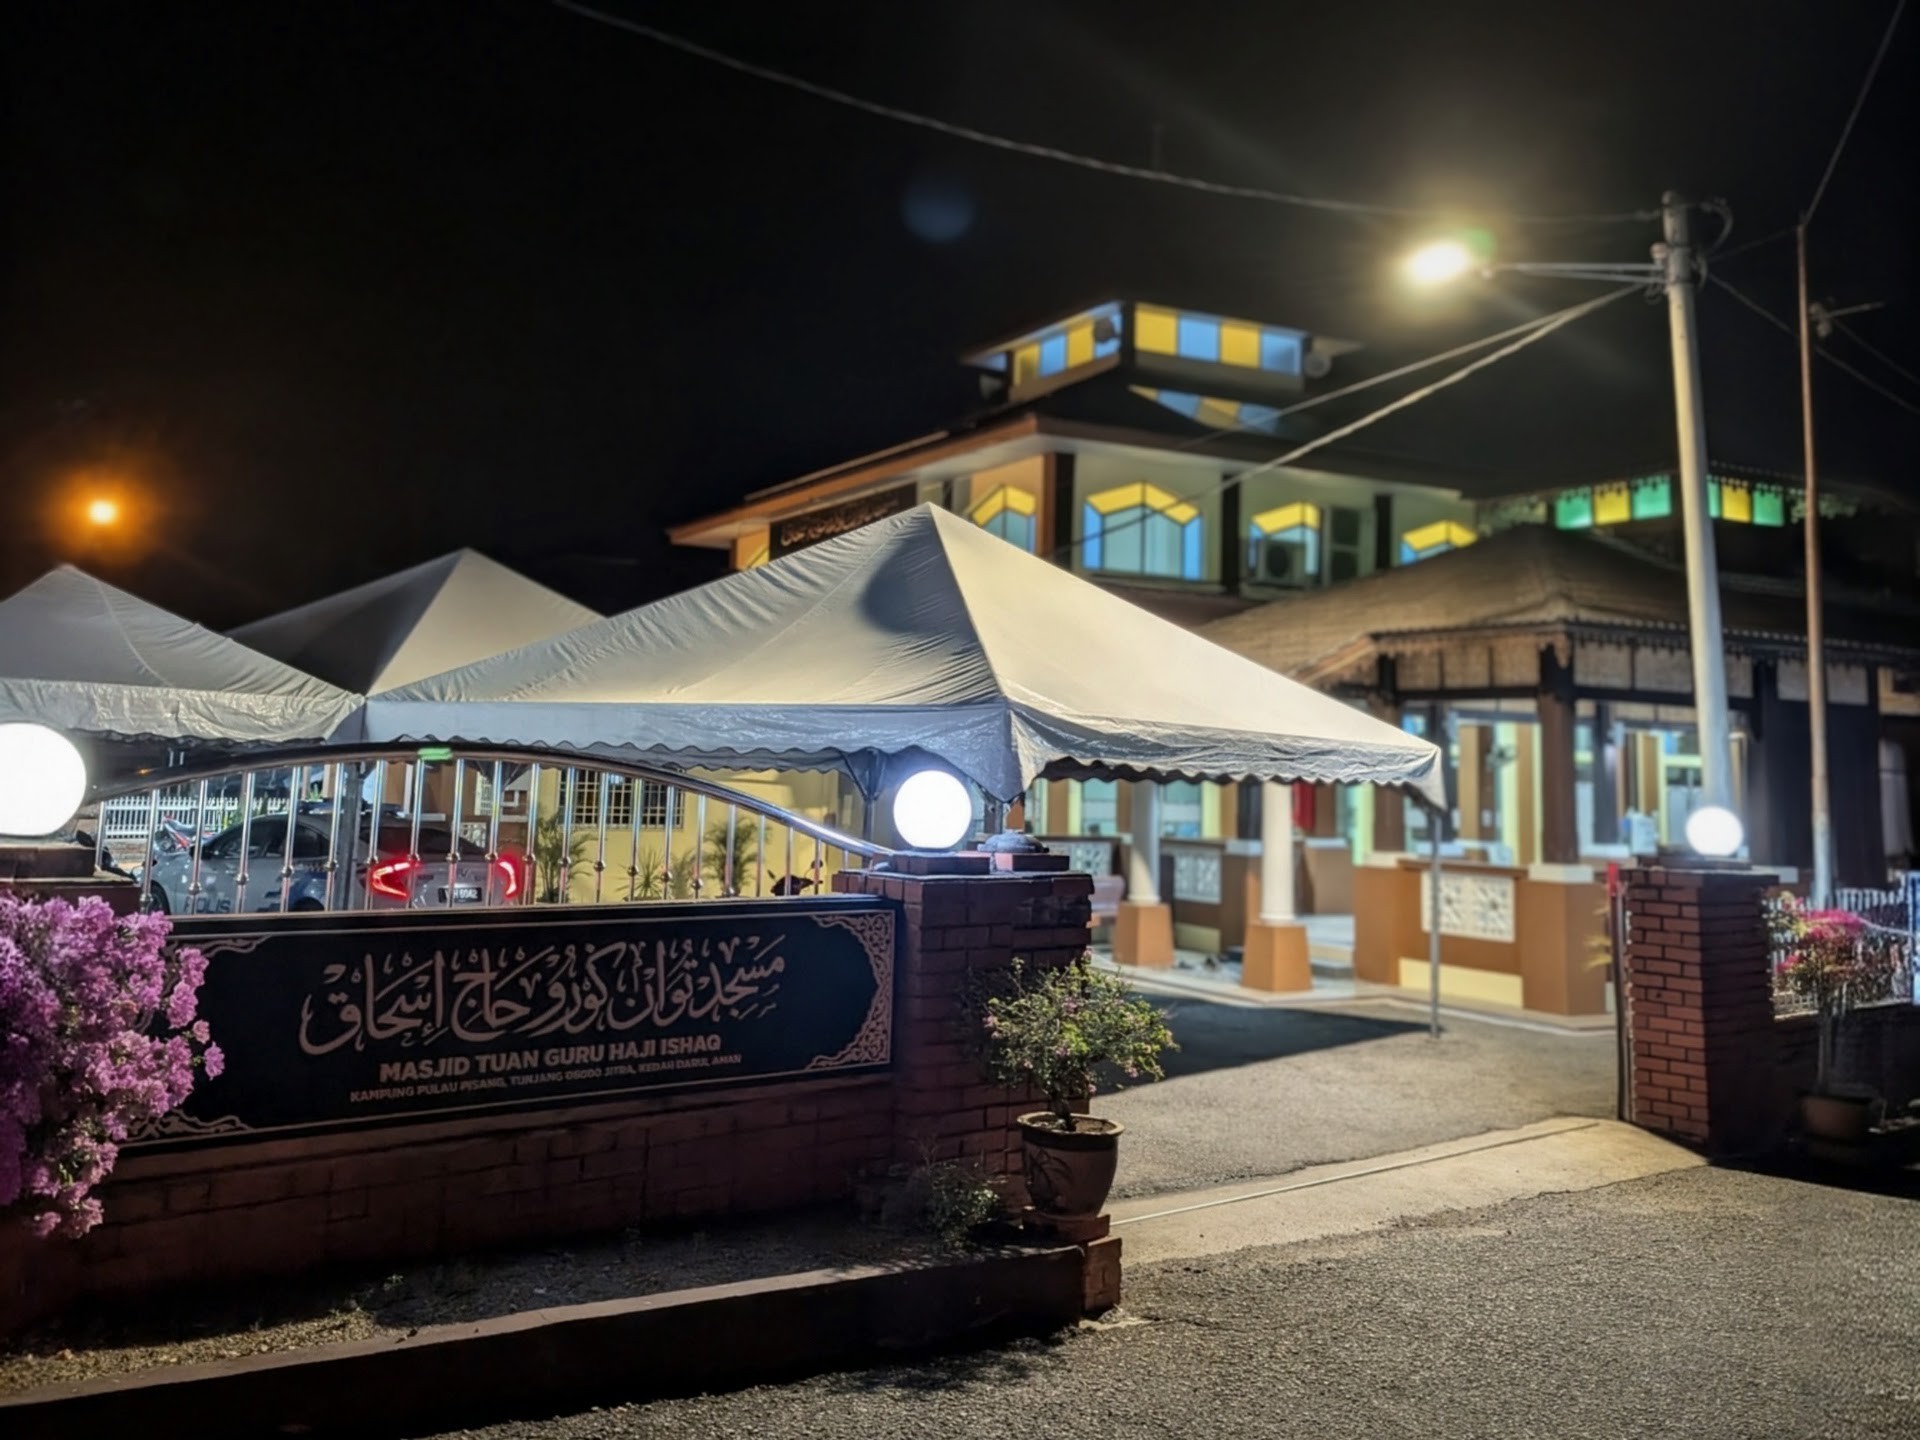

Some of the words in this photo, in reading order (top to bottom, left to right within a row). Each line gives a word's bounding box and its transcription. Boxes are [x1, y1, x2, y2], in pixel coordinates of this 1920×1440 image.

[689, 934, 785, 1021] مسجد
[350, 1086, 414, 1101] KAMPUNG
[417, 1082, 458, 1096] PULAU
[511, 1072, 563, 1086] TUNJANG
[638, 1061, 674, 1074] KEDAH
[676, 1058, 710, 1070] DARUL
[711, 1054, 742, 1066] AMAN
[379, 1056, 470, 1082] MASJID
[476, 1050, 539, 1073] TUAN
[544, 1044, 604, 1067] GURU
[608, 1039, 656, 1061] HAJI
[660, 1034, 721, 1055] ISHAQ
